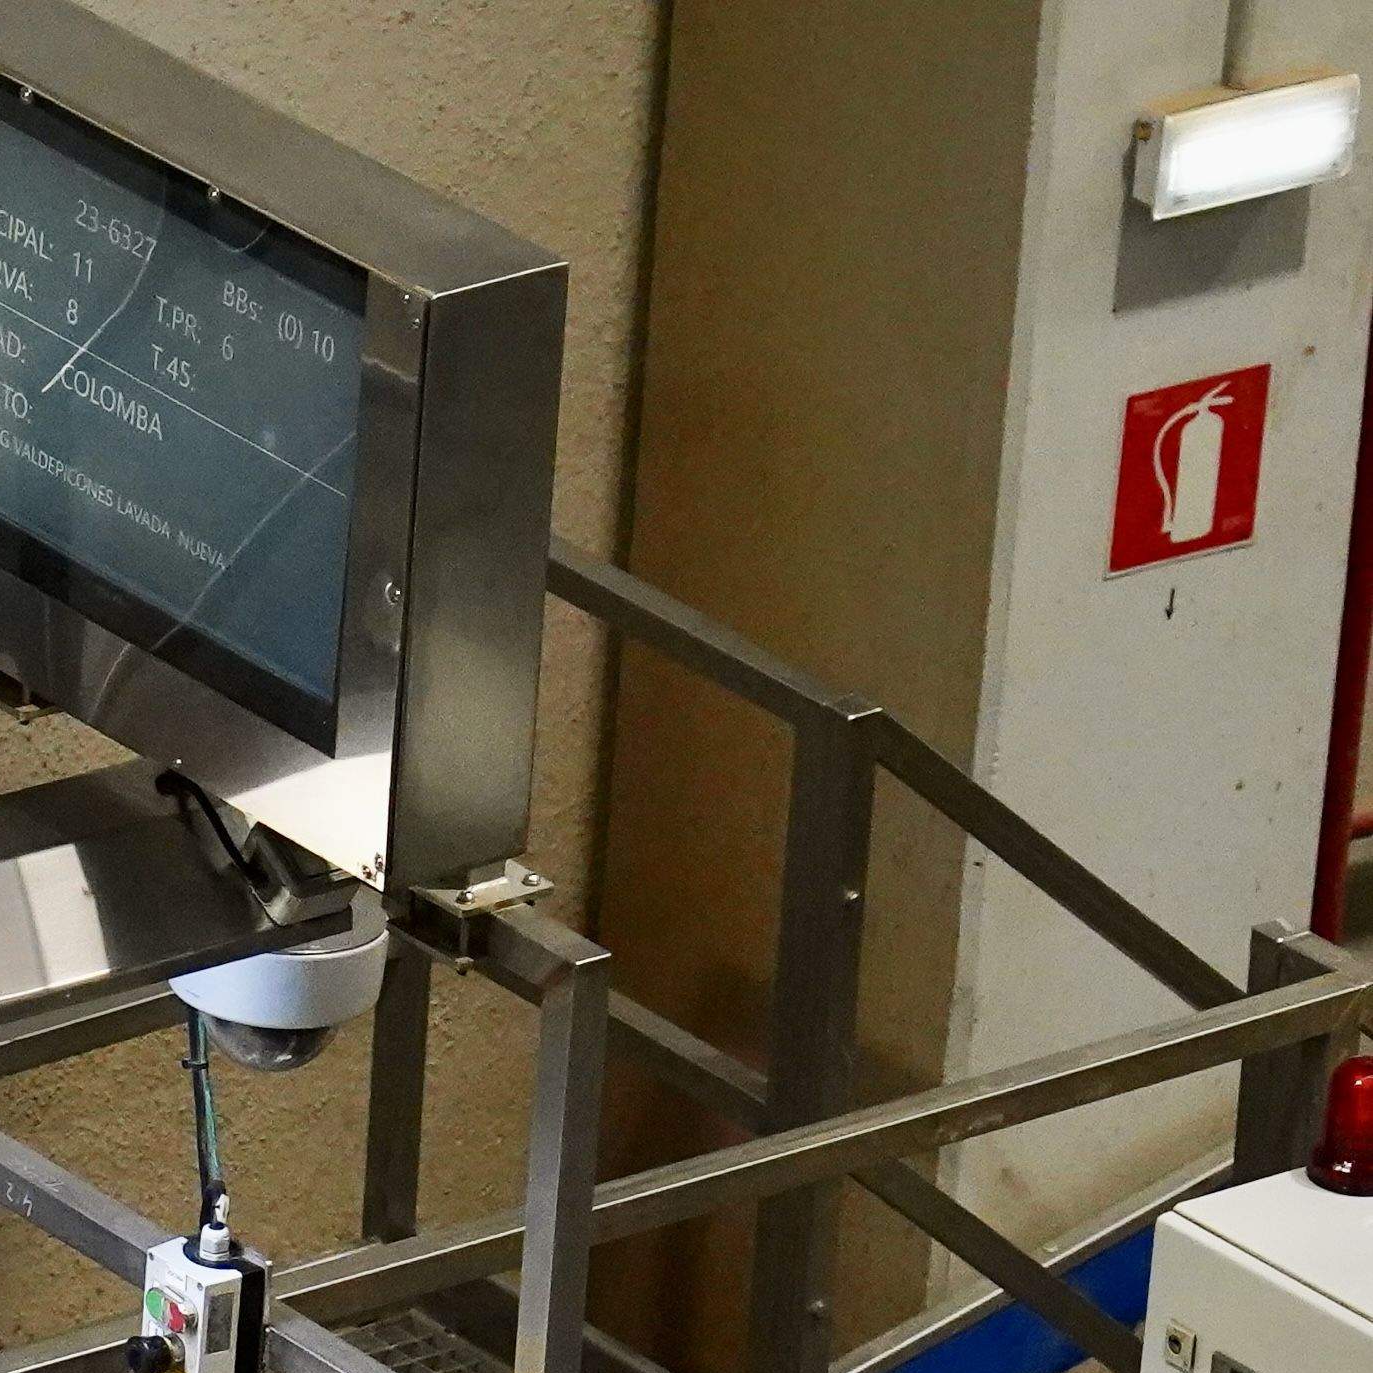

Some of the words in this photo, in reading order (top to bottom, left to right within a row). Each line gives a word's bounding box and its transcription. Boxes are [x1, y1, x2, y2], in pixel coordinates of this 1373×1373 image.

[66, 298, 78, 326] 8
[73, 251, 94, 284] 11
[221, 335, 234, 361] 6
[277, 311, 304, 349] (0)
[312, 330, 336, 363] 10
[59, 364, 162, 440] COLOMBA
[117, 496, 171, 540] LAVADA
